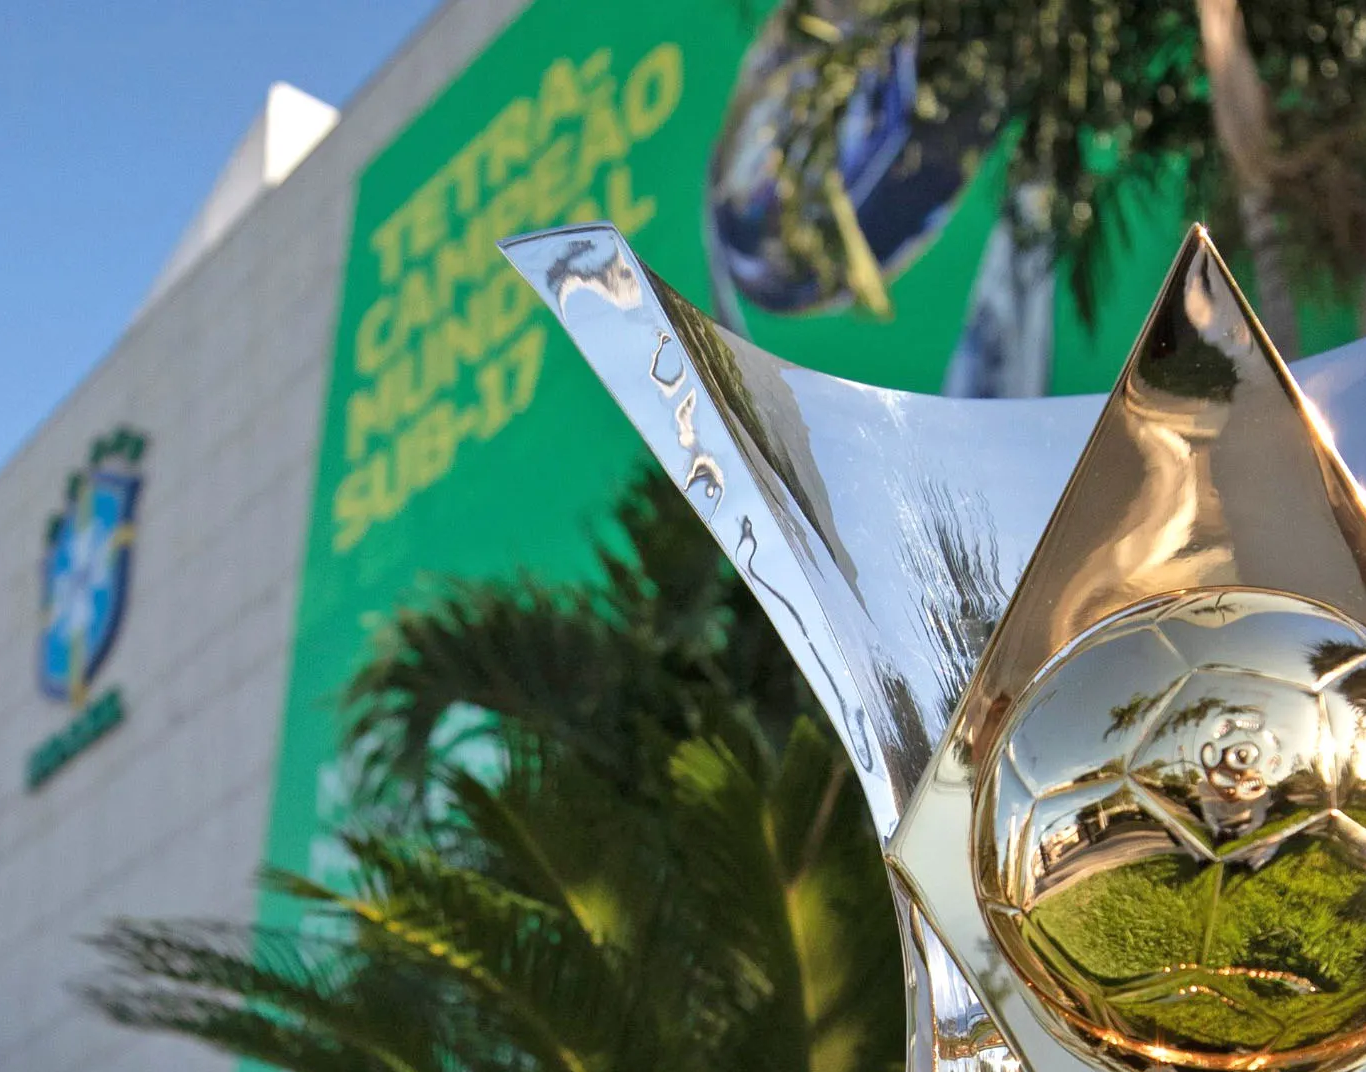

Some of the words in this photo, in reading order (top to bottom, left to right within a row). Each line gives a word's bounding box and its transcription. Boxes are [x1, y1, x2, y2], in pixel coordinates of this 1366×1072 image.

[370, 47, 614, 285] TETRA-
[346, 164, 656, 460] MUNDL
[333, 326, 546, 554] SUB-17
